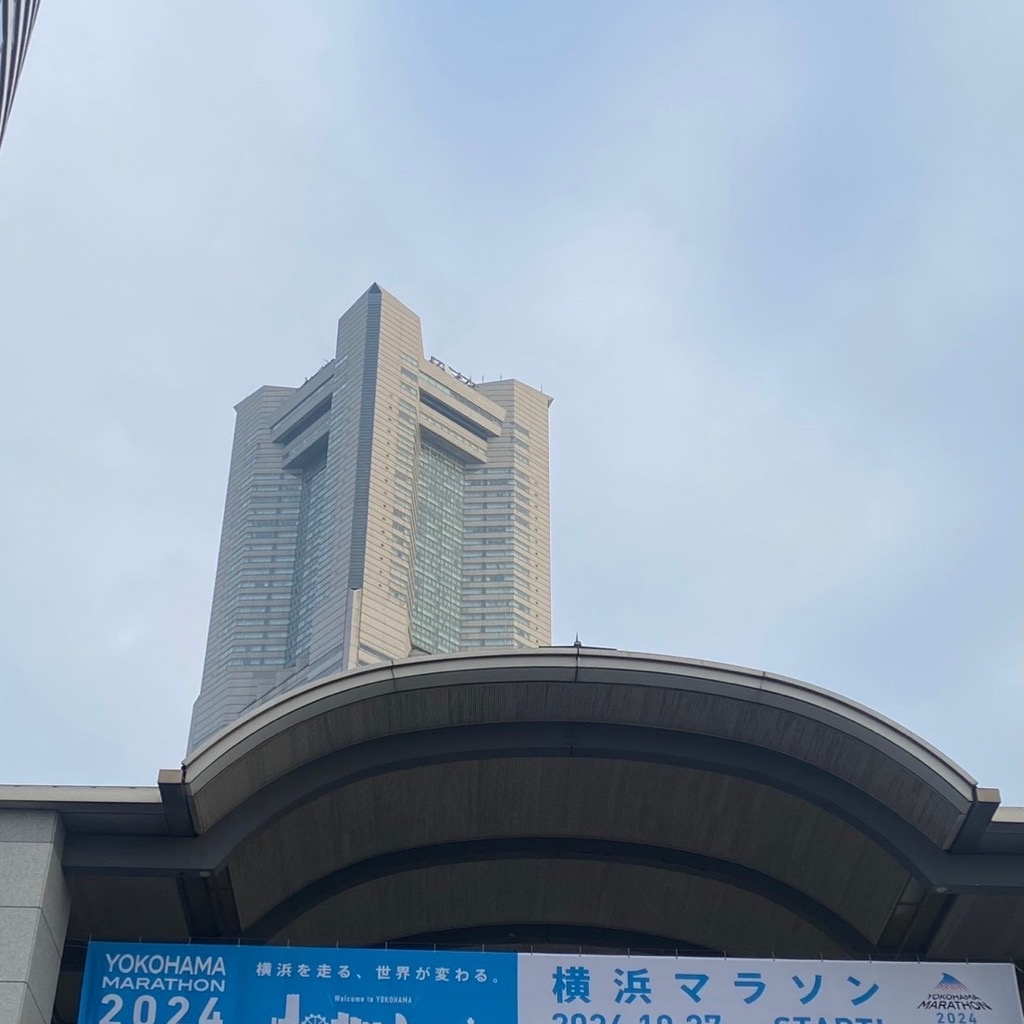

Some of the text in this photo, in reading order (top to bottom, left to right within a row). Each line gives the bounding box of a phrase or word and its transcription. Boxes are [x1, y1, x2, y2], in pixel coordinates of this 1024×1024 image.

[105, 953, 227, 976] YOKOHAMA
[255, 961, 499, 984] 横浜を走る、世界が変わる。
[101, 976, 226, 992] MARATHON
[552, 965, 880, 1007] 横浜マラソン
[334, 995, 365, 1003] Welcome
[375, 995, 413, 1004] YOKOHAMA
[927, 993, 982, 1001] YOKOHAMA
[917, 1000, 993, 1011] MARATHON
[936, 1012, 978, 1024] 2024
